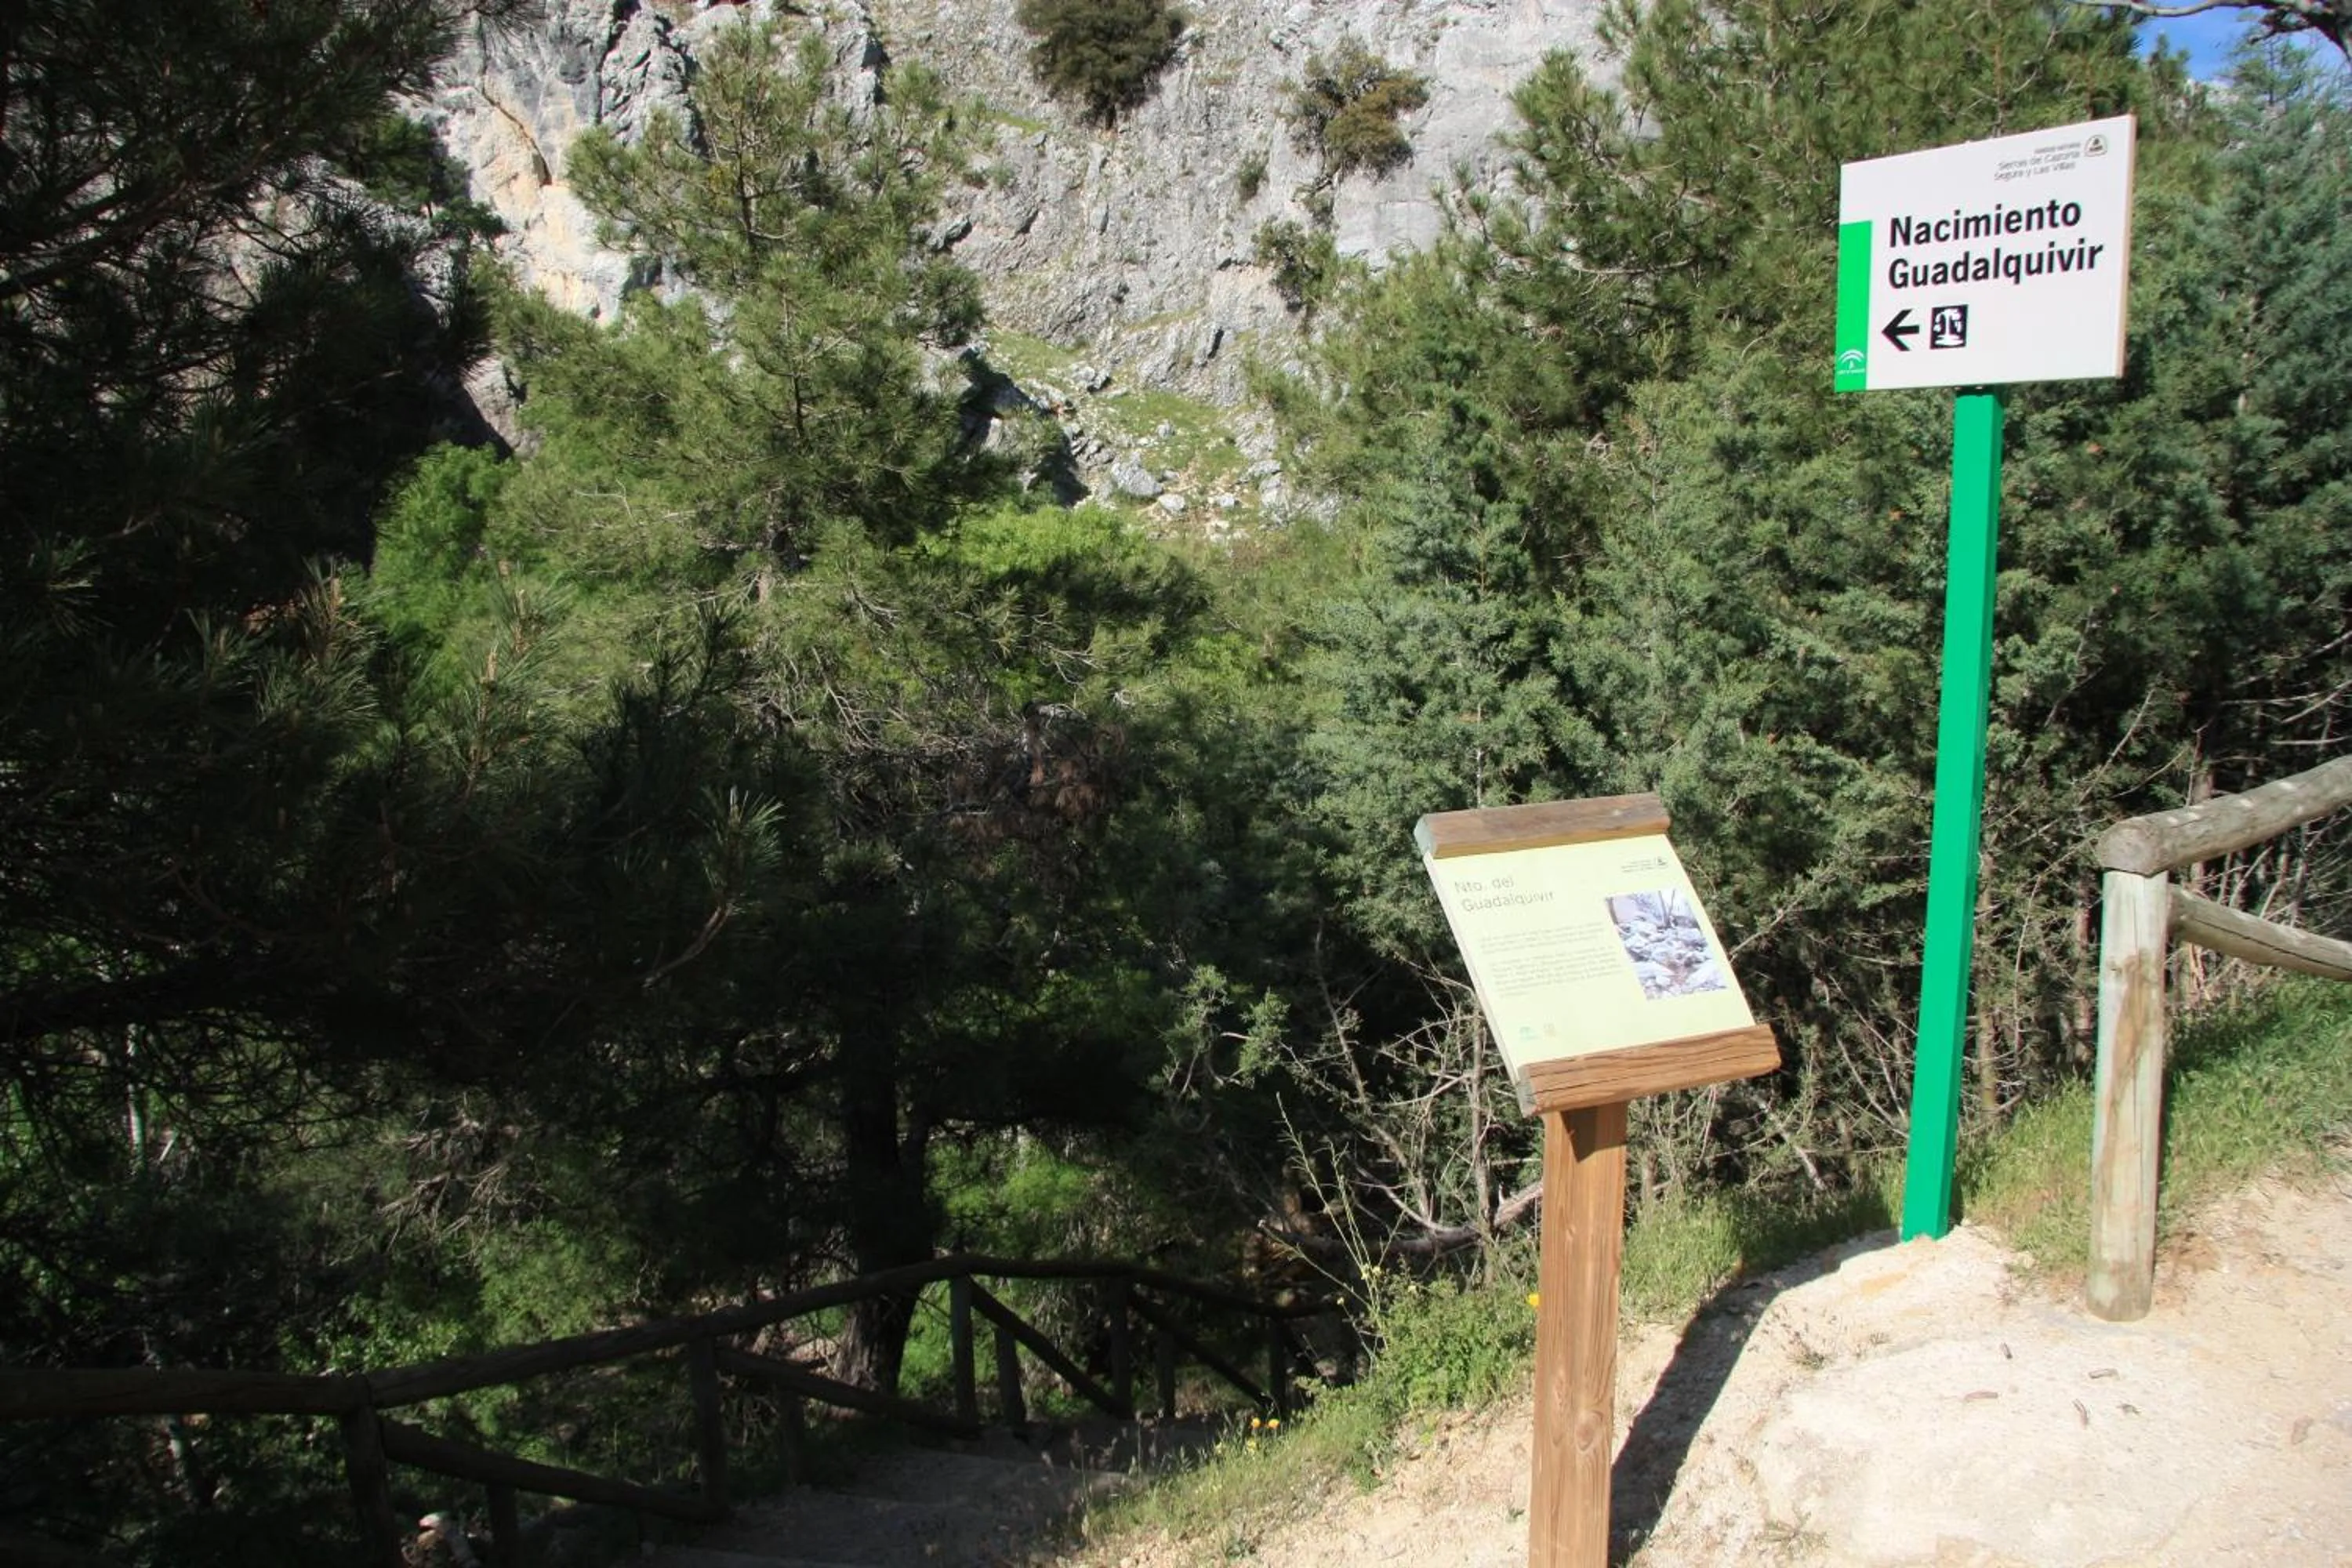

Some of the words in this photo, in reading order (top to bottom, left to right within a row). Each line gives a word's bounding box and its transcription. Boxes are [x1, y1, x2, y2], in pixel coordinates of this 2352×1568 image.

[1889, 199, 2082, 248] Nacimiento
[1889, 239, 2104, 289] Guadalquivir
[1492, 876, 1515, 888] del
[1462, 891, 1555, 912] Guadalquivir
